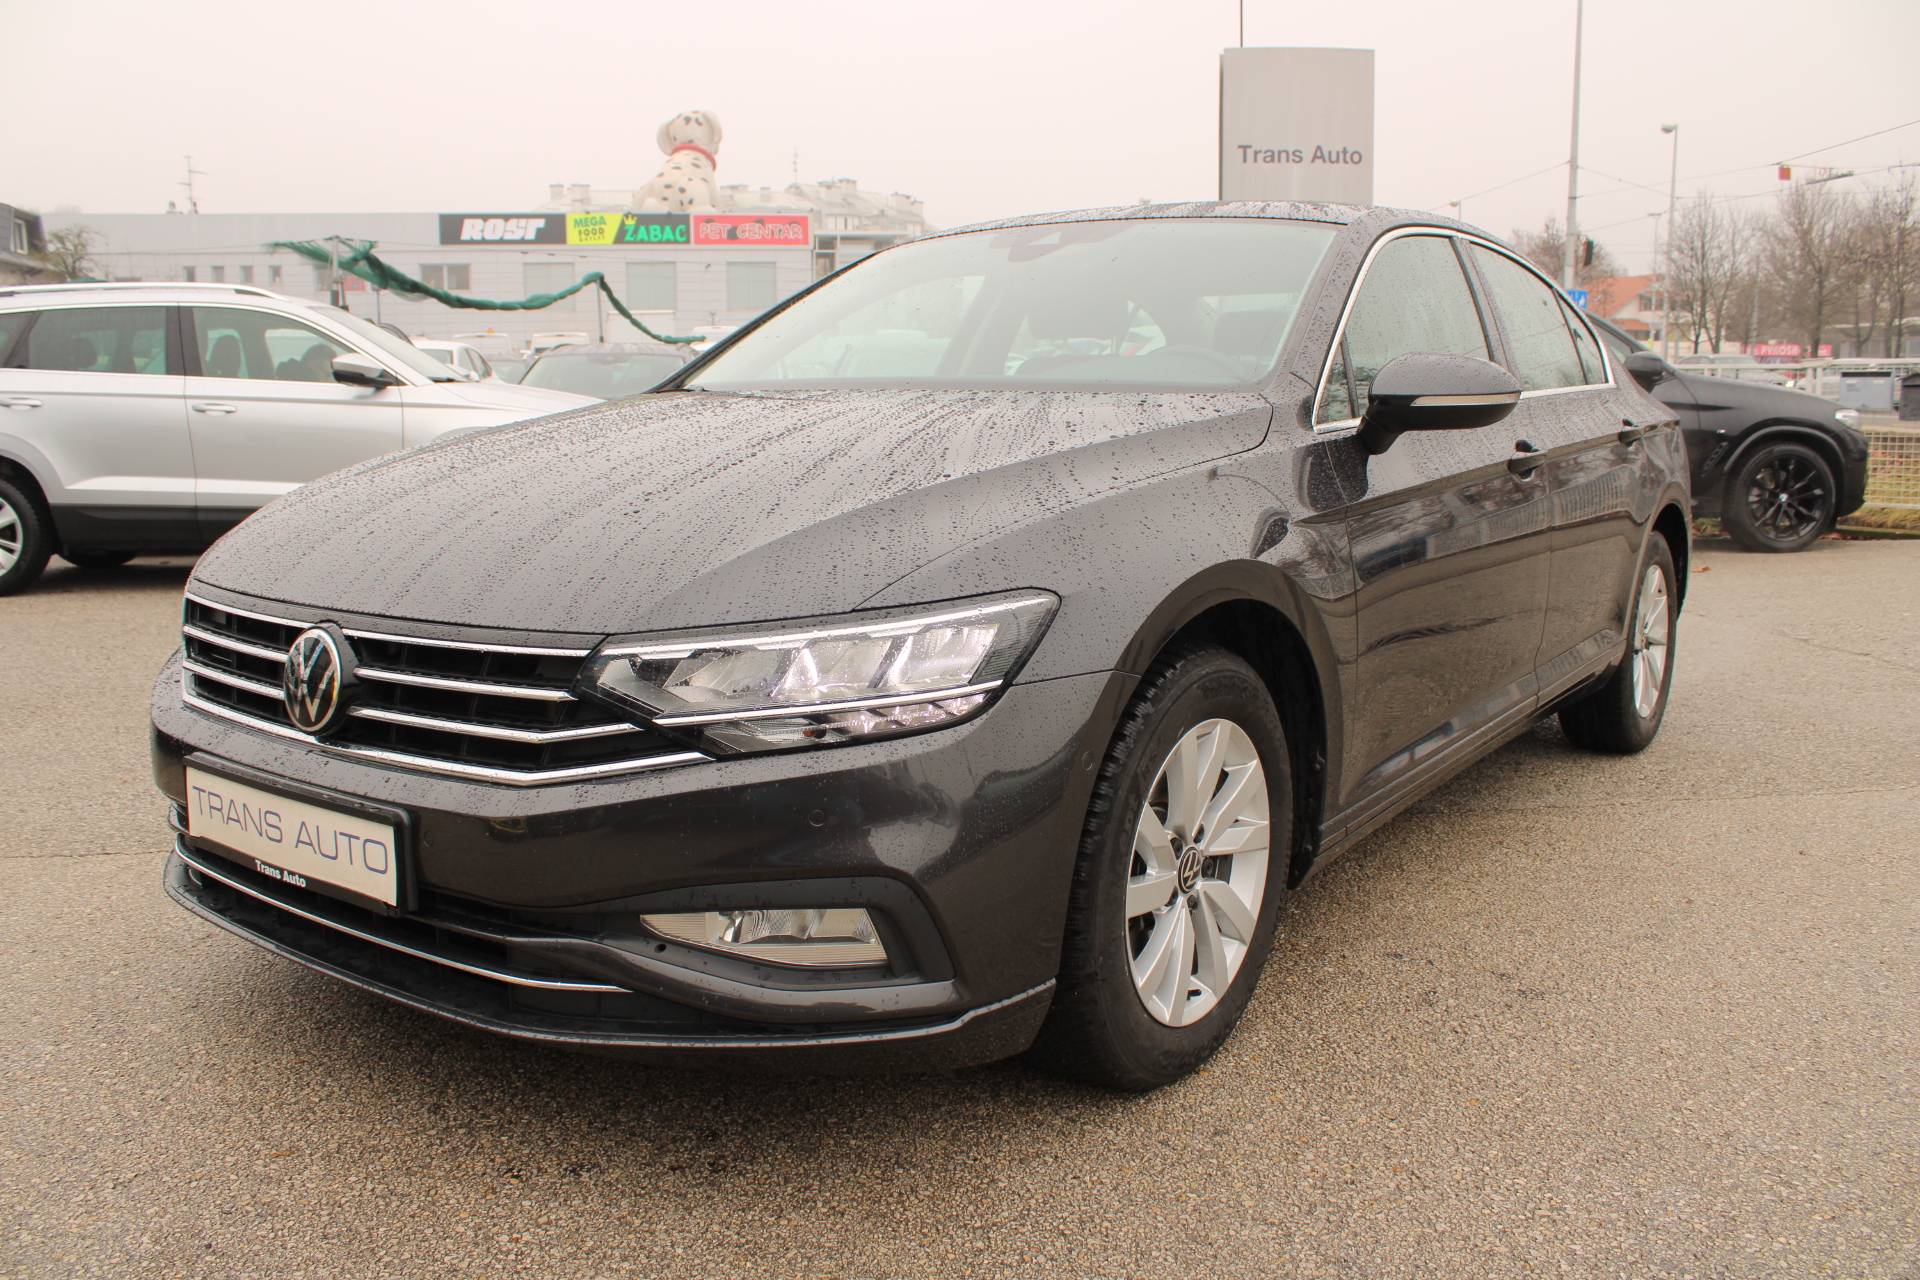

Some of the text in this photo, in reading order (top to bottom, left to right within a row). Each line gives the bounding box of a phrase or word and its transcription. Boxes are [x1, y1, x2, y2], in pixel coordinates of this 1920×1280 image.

[1237, 144, 1363, 165] Trans Auto
[460, 218, 546, 240] ROST
[573, 216, 607, 229] MEGA
[577, 227, 606, 236] FOOD
[700, 222, 803, 241] PET CENTAR
[192, 786, 389, 875] TRANS AUTO
[255, 859, 307, 888] Trans Auto
